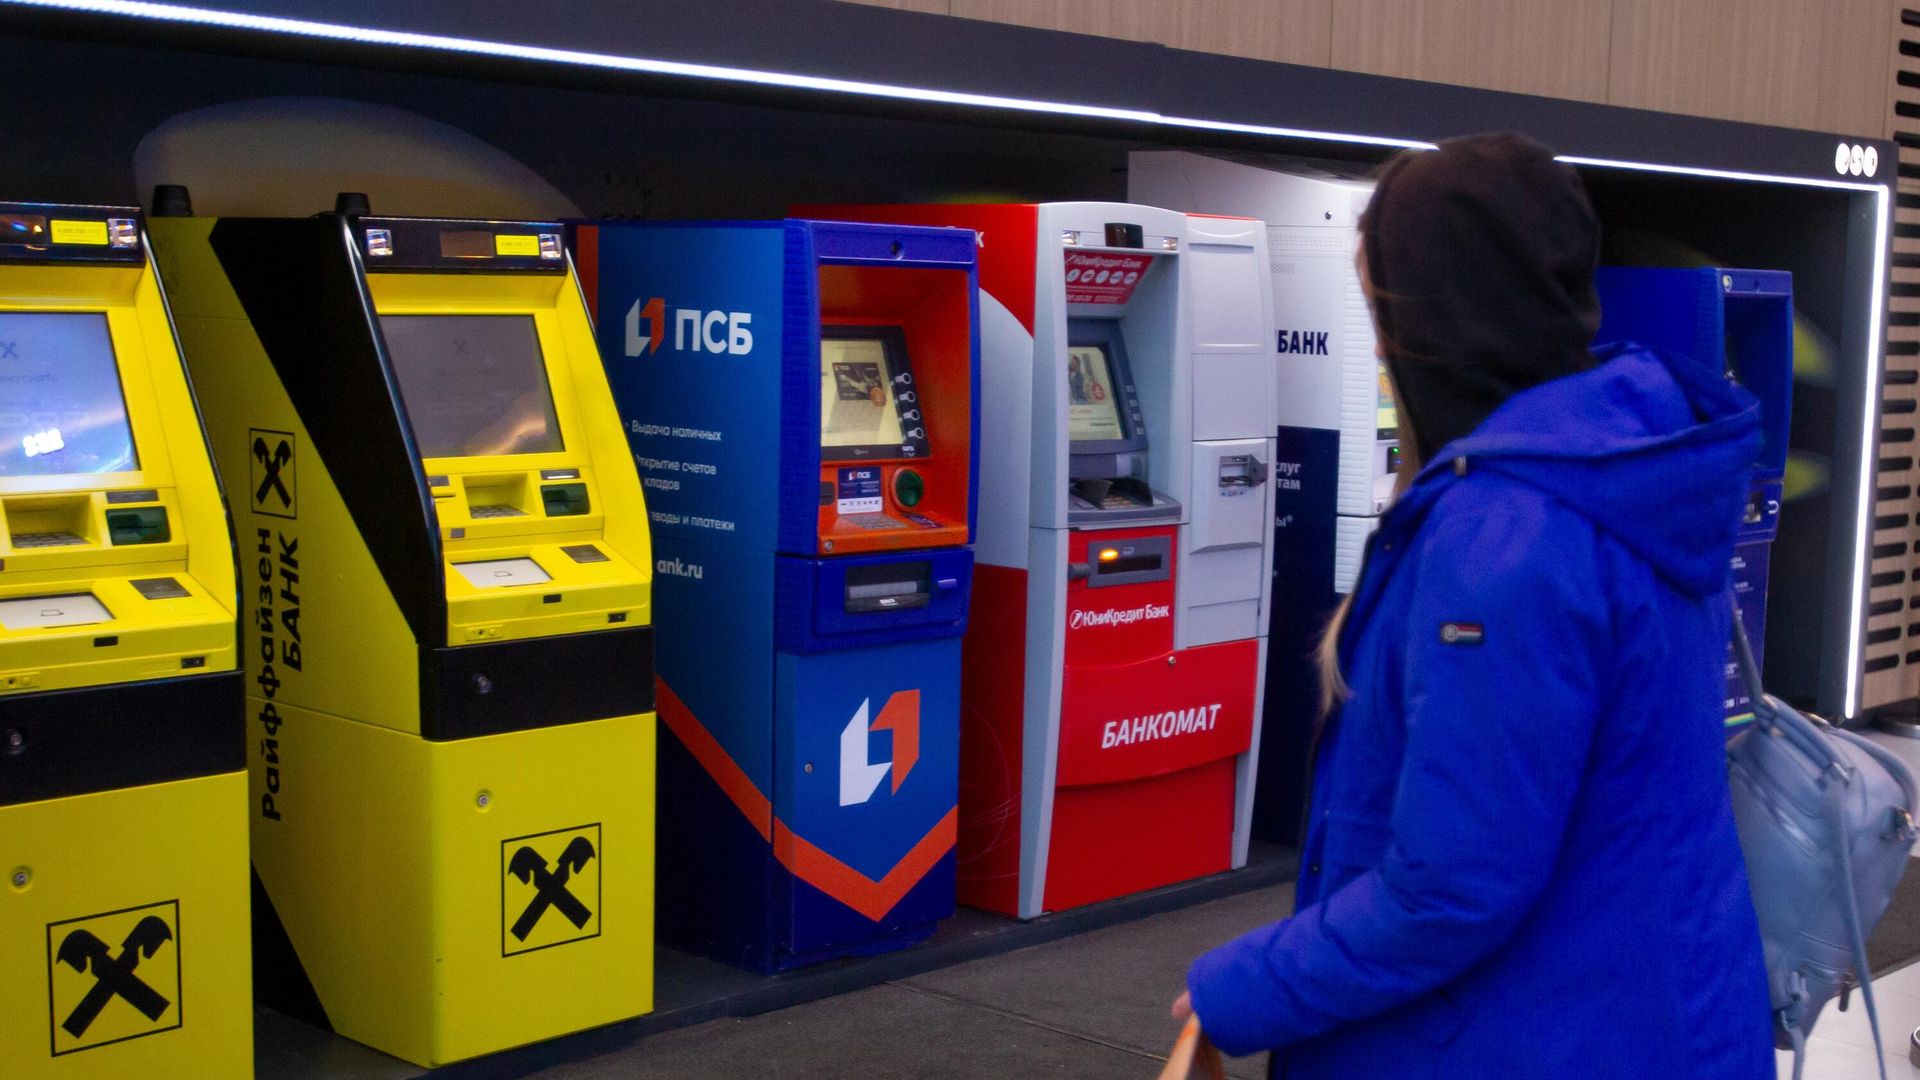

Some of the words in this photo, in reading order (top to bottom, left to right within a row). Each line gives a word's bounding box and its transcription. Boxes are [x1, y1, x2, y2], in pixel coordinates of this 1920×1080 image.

[675, 308, 753, 355] ПСБ
[1275, 329, 1329, 356] БАНК
[631, 420, 670, 436] Выдача
[672, 426, 721, 441] наличных
[636, 454, 680, 471] ткрытие
[682, 461, 717, 475] счетов
[644, 477, 680, 491] кладов
[1276, 478, 1301, 490] там
[682, 516, 689, 526] и
[691, 516, 735, 531] платежи
[657, 557, 703, 579] ank.ru
[279, 530, 302, 672] БАНК
[1083, 607, 1144, 627] ЮниКредит
[1145, 604, 1170, 619] Банк
[256, 527, 282, 822] Райффайзен
[1101, 703, 1222, 749] БАНКОМАТ
